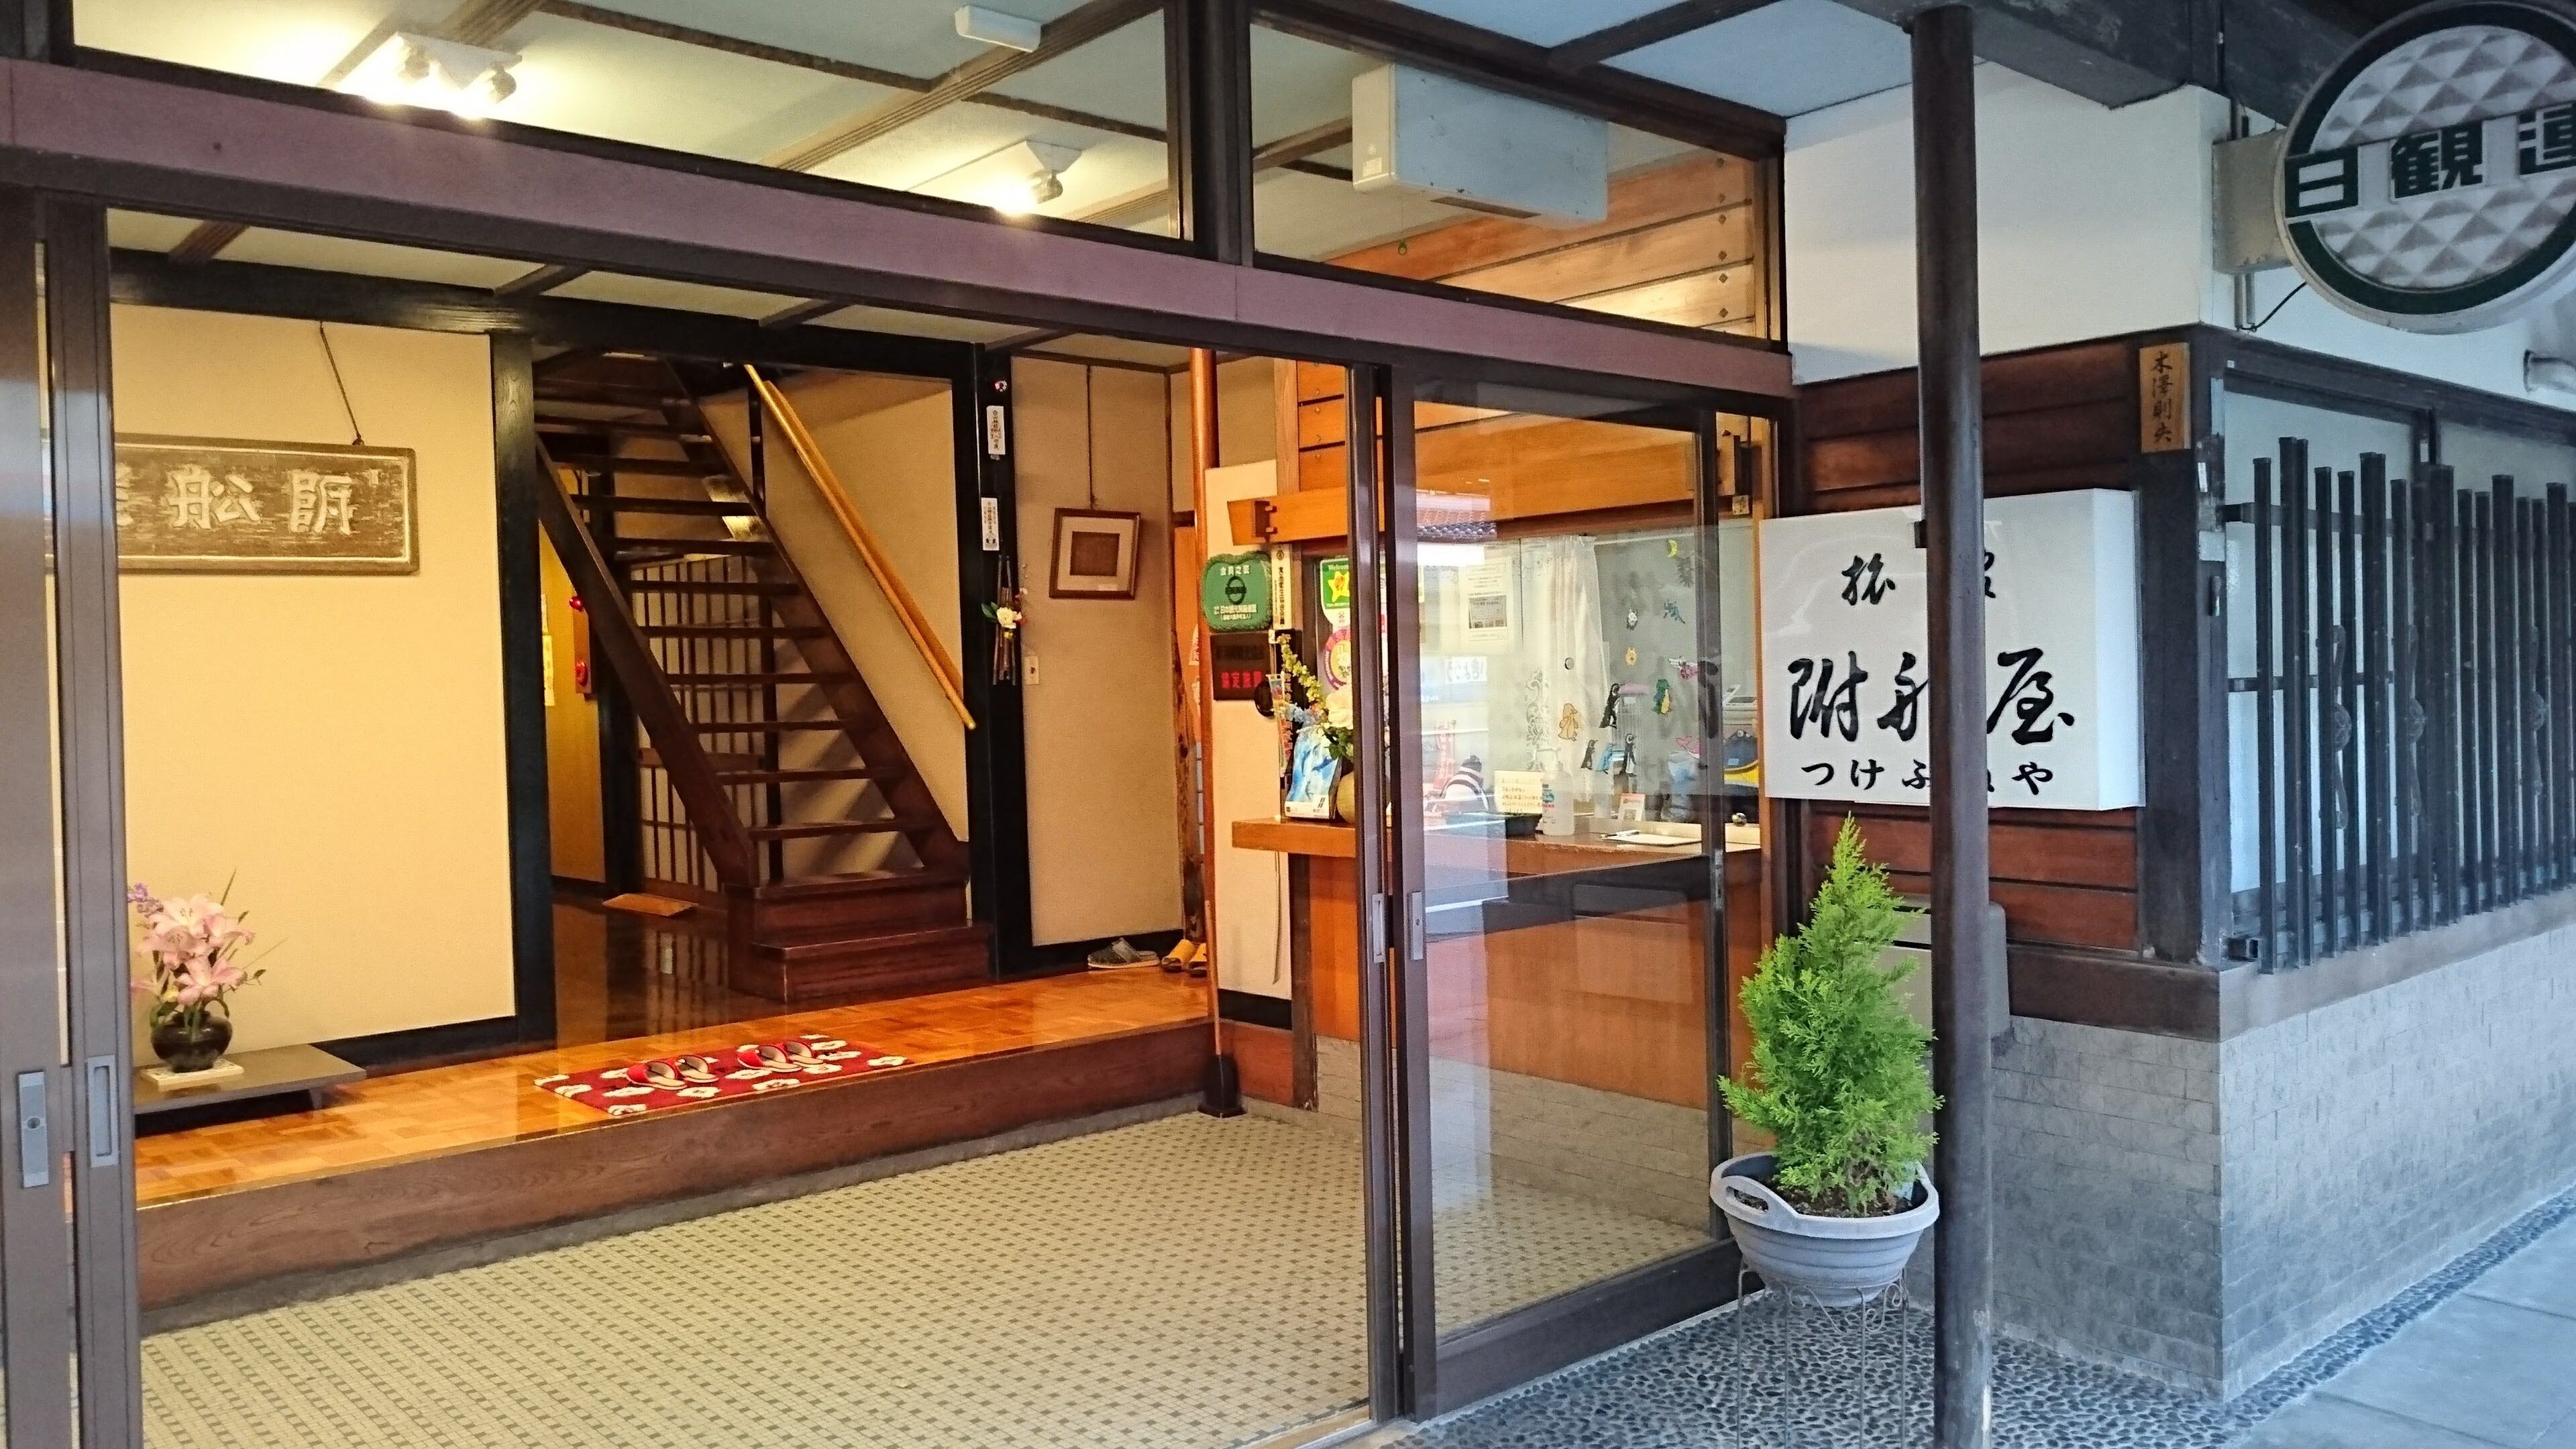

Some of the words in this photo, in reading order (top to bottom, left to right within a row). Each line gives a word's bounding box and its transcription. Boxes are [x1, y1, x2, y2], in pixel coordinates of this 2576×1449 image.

[1841, 551, 1996, 606] 旅
[1801, 759, 2053, 796] つけふや
